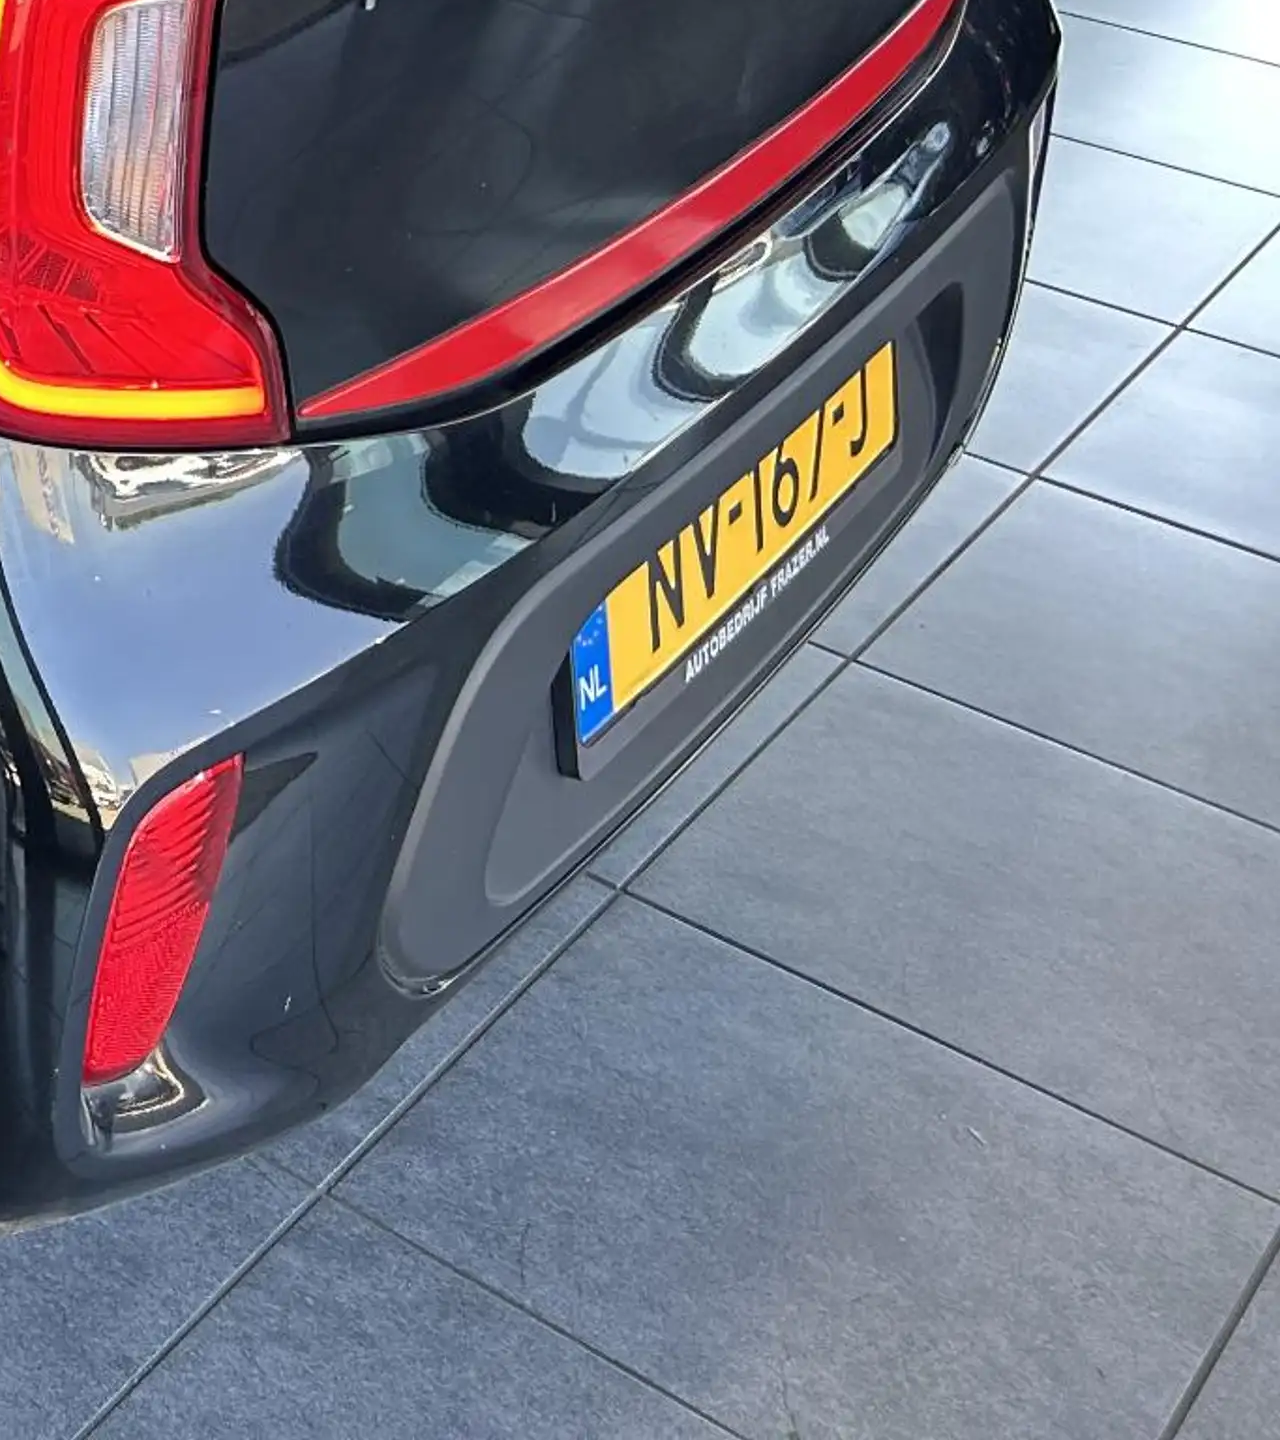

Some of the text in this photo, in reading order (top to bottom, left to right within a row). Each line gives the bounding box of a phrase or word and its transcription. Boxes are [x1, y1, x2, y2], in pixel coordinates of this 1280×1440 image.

[684, 525, 830, 684] AUTOBEDRIJF FRAZER.NL
[578, 662, 607, 712] NL
